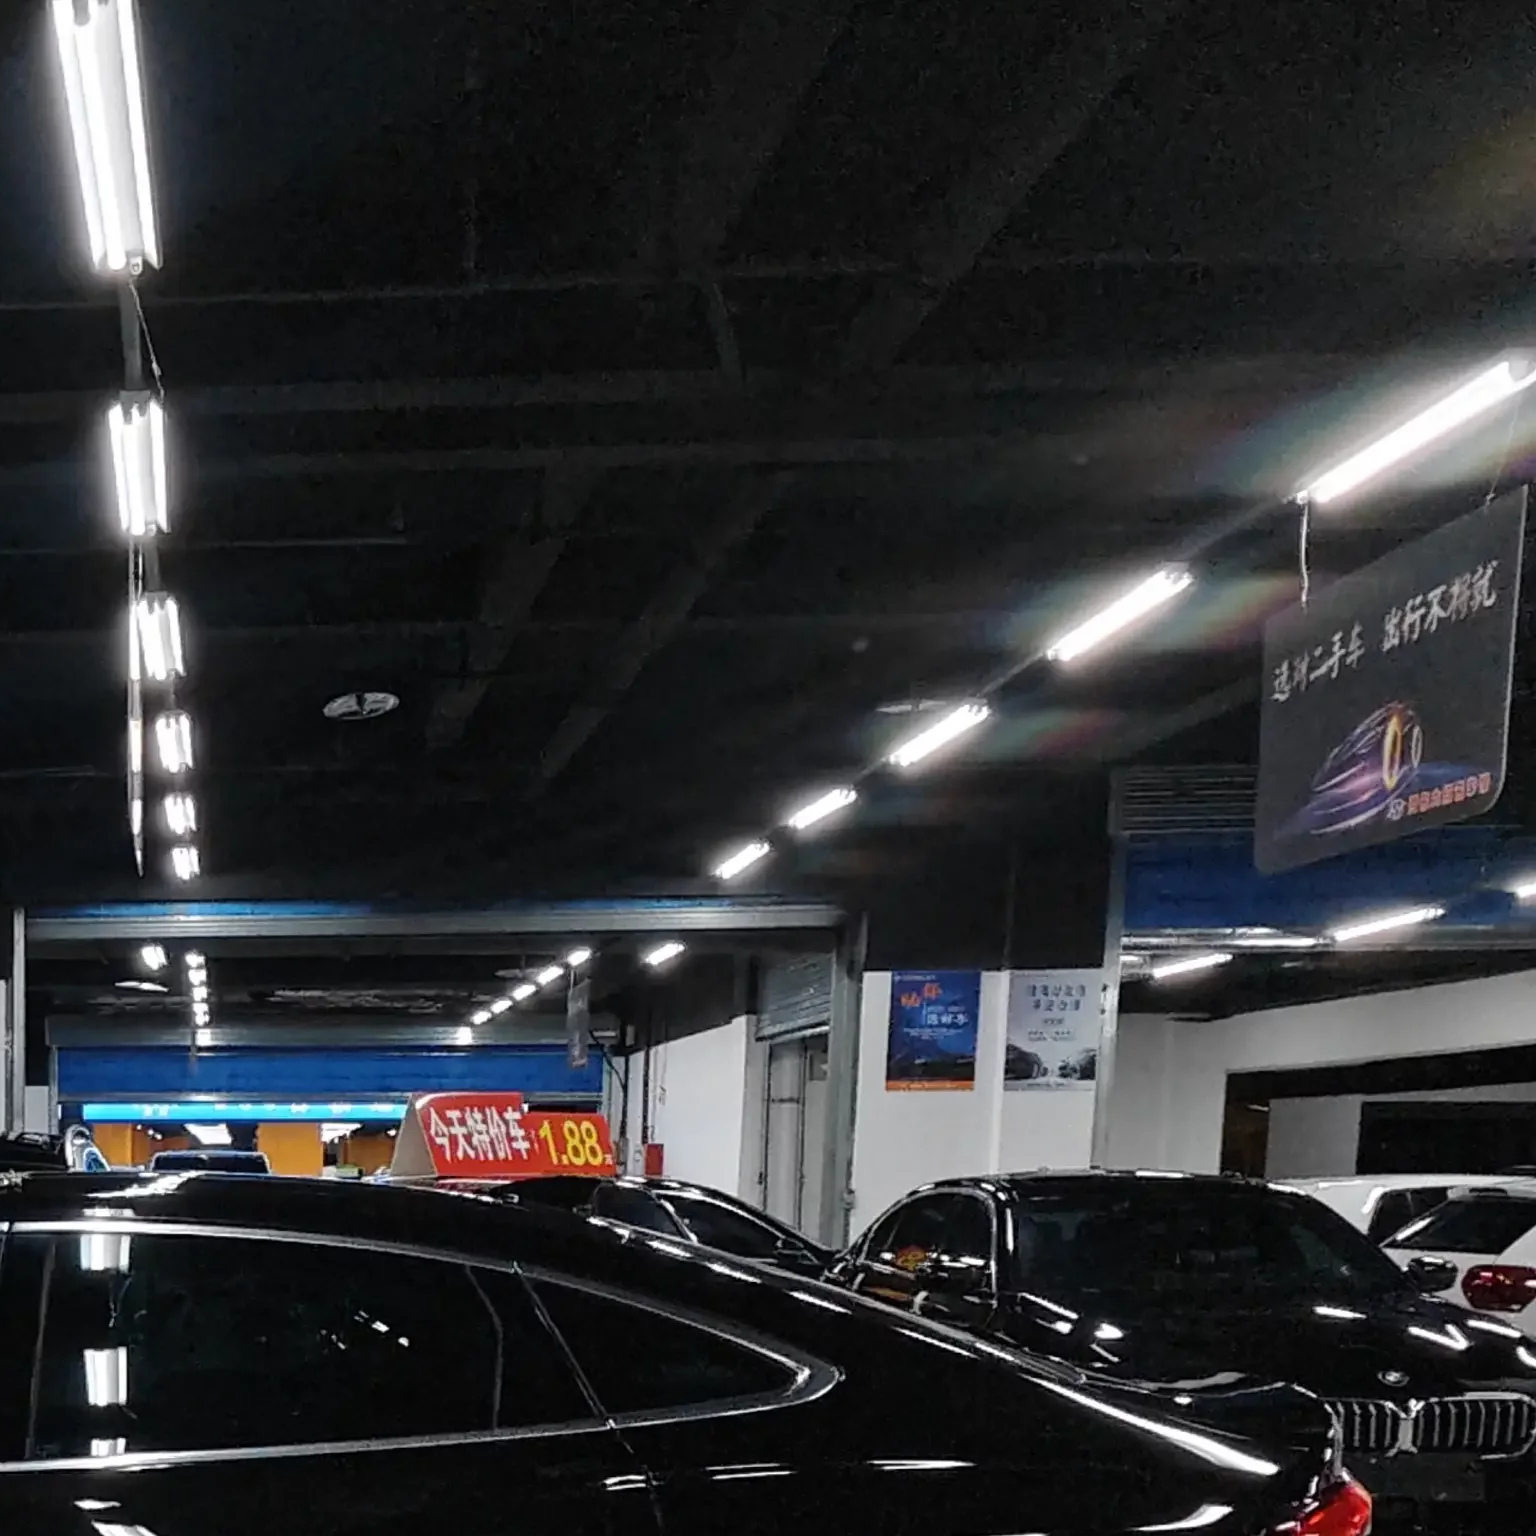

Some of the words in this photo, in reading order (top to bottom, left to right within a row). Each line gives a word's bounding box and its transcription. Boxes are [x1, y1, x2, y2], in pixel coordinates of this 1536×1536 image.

[1380, 560, 1499, 652] 出行不将就
[429, 1106, 530, 1163] 今天特价车
